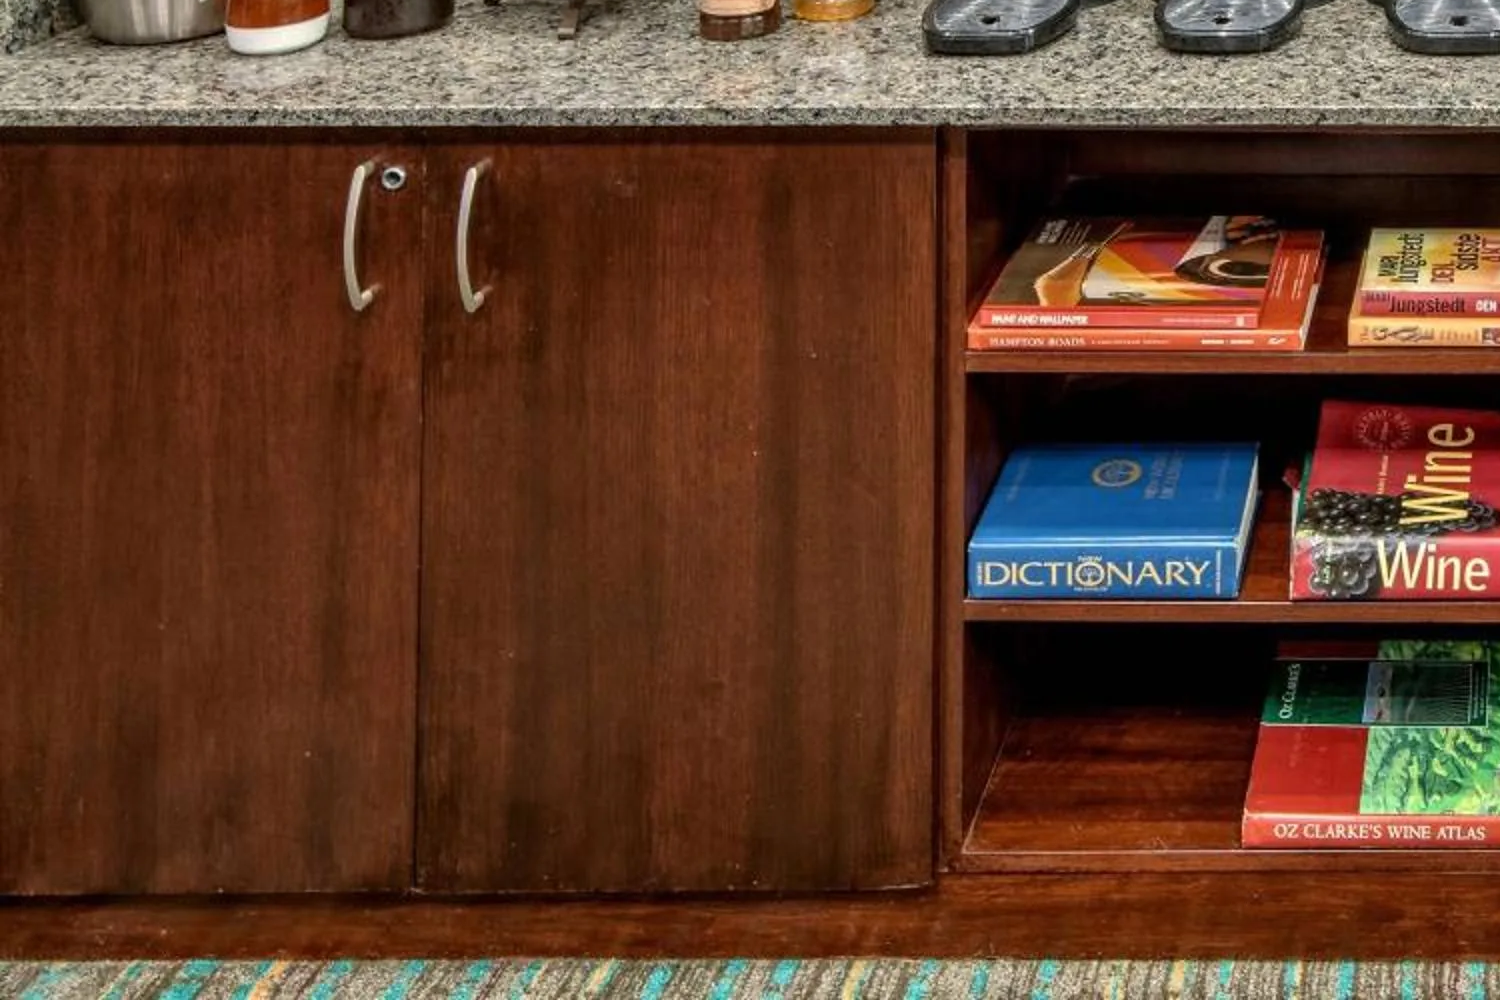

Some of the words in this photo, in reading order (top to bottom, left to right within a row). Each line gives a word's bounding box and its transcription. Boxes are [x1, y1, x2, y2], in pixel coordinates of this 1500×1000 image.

[1389, 296, 1466, 317] Jungstedt
[1475, 299, 1497, 313] DEN
[989, 336, 1044, 347] HAMPTON
[1399, 423, 1475, 525] Wine
[984, 560, 1211, 588] DICTIONARY
[1377, 540, 1490, 591] Wine
[1273, 824, 1298, 838] OZ
[1303, 823, 1382, 839] CLARKE'S
[1387, 826, 1431, 839] WINE
[1436, 826, 1486, 841] ATLAS
